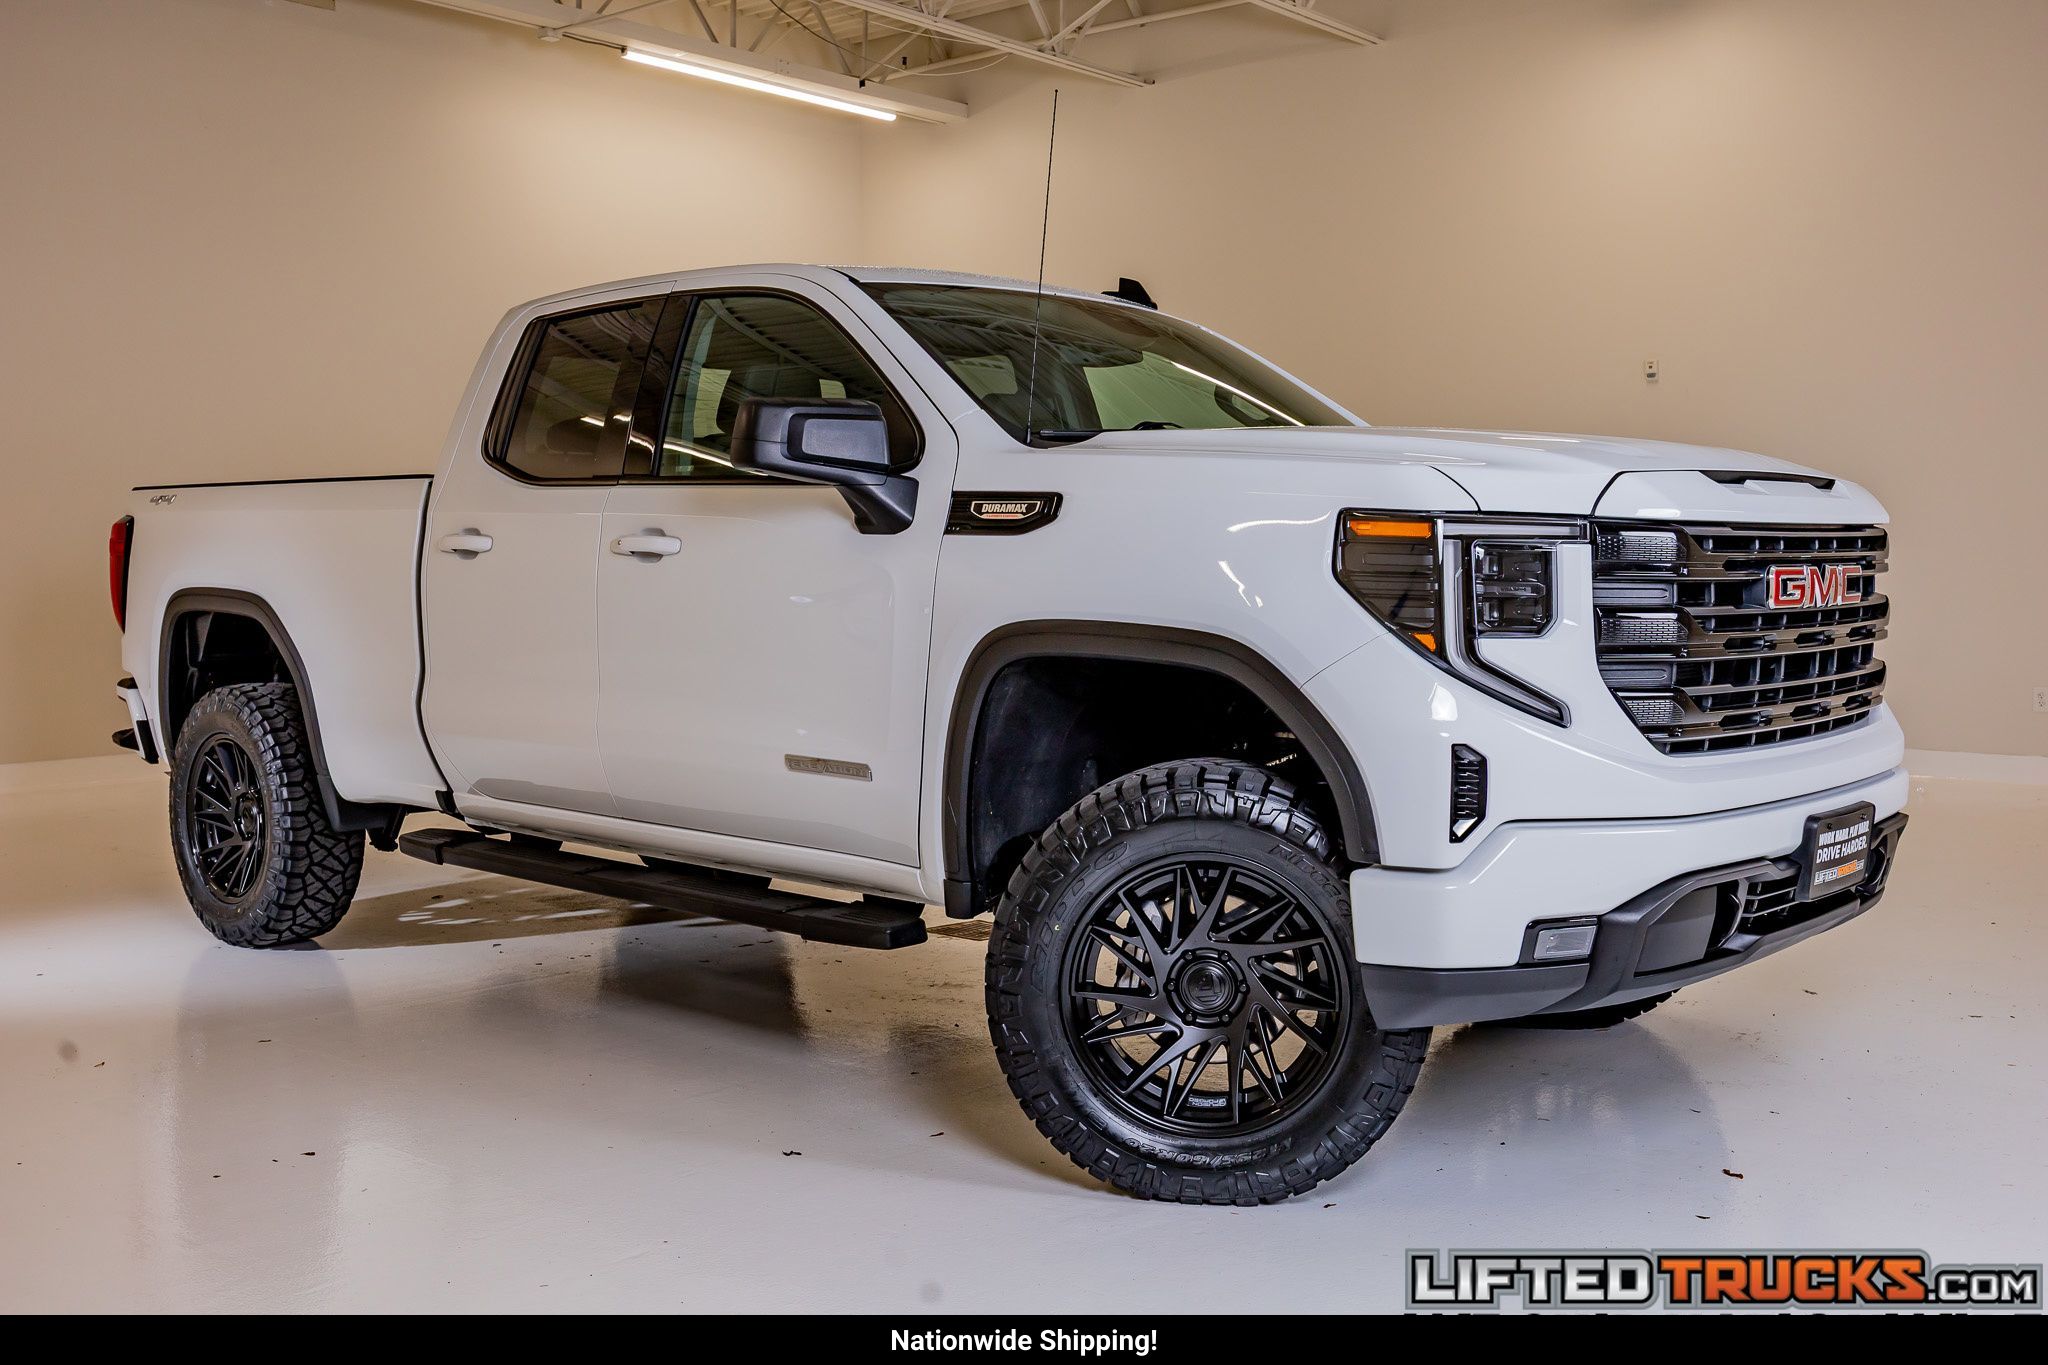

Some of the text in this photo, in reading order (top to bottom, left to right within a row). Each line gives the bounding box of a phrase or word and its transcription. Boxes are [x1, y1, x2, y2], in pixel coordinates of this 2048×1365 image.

[981, 503, 1028, 513] DURAMAX
[1765, 563, 1862, 609] GMC
[1816, 835, 1867, 864] DRIVE HARDER.
